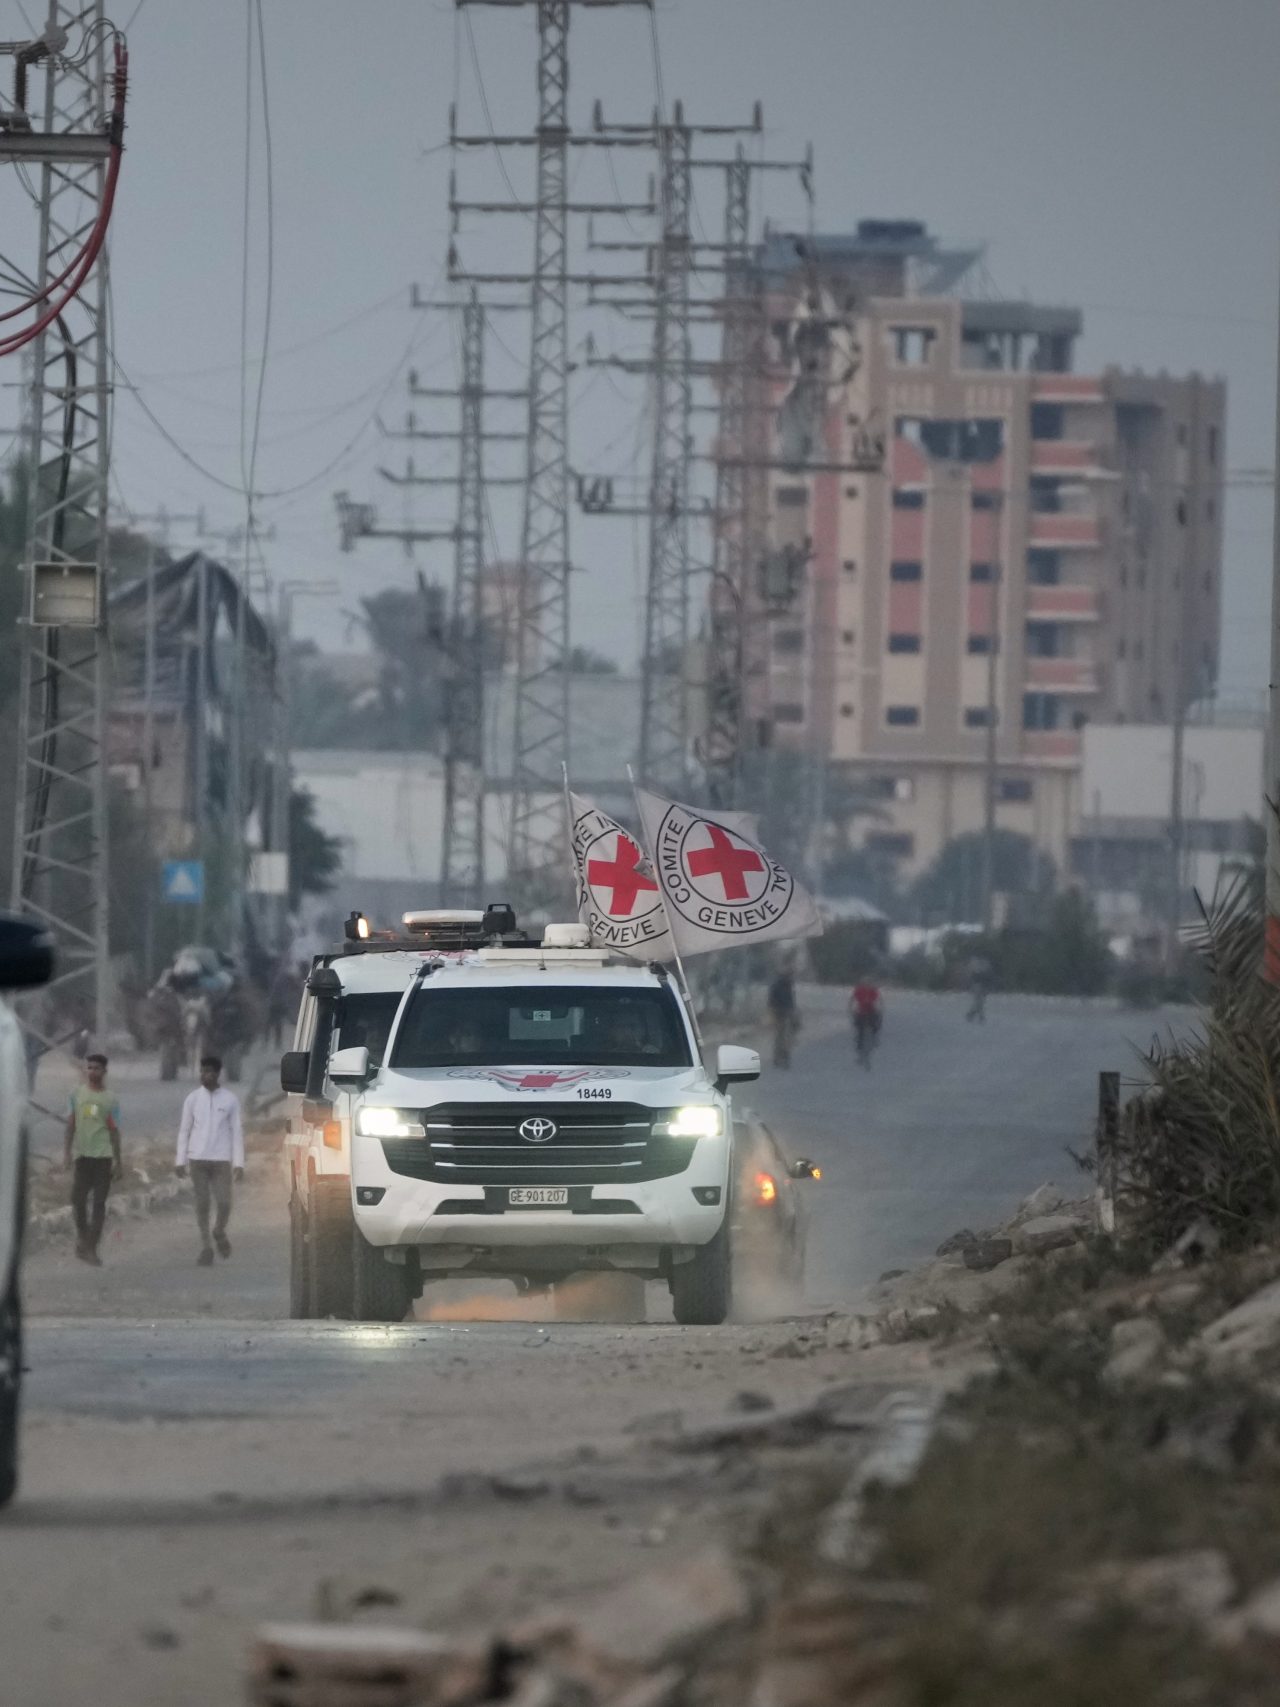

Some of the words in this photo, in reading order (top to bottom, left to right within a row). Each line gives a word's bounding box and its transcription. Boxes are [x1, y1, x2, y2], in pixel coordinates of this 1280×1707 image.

[663, 819, 691, 904] COMITE
[589, 912, 655, 942] GENEVE
[698, 901, 779, 928] GENEVE
[576, 1088, 612, 1099] 18449
